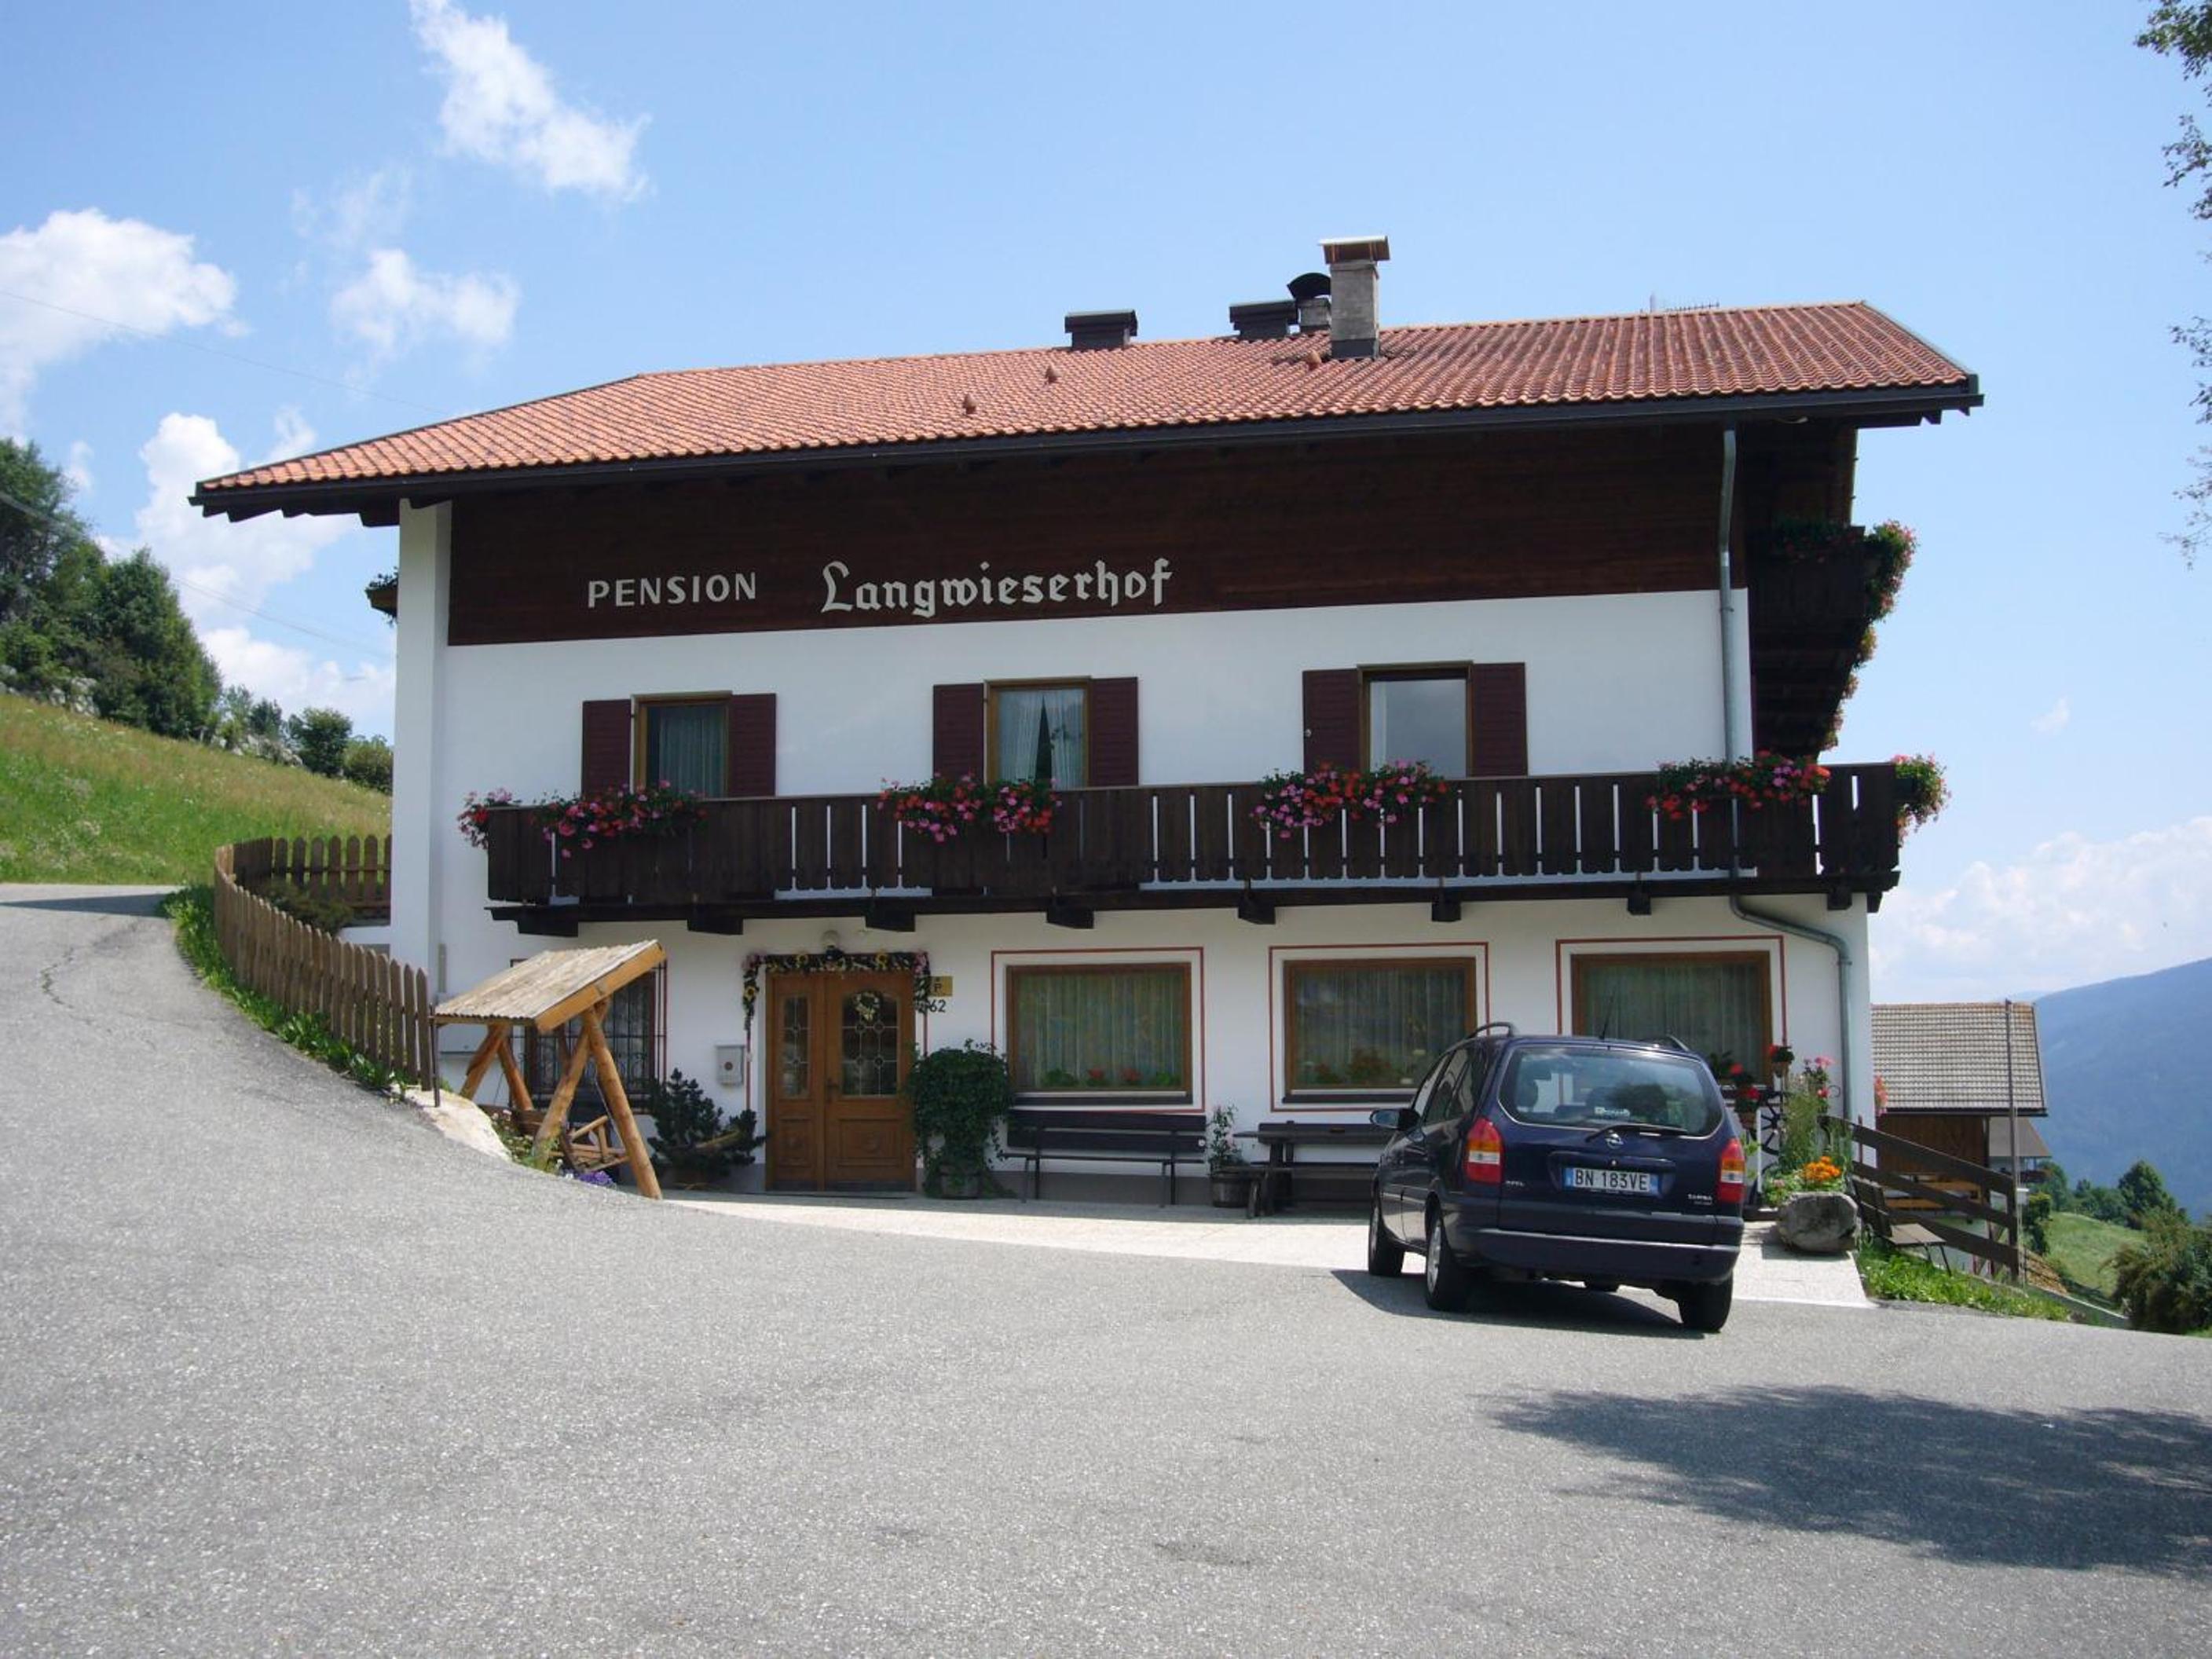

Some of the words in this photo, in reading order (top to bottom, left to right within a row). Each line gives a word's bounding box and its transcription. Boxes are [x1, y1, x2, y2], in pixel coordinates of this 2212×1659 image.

[588, 572, 756, 608] PENSION
[821, 557, 1173, 618] Langwieserhof
[1575, 1169, 1594, 1186] BN
